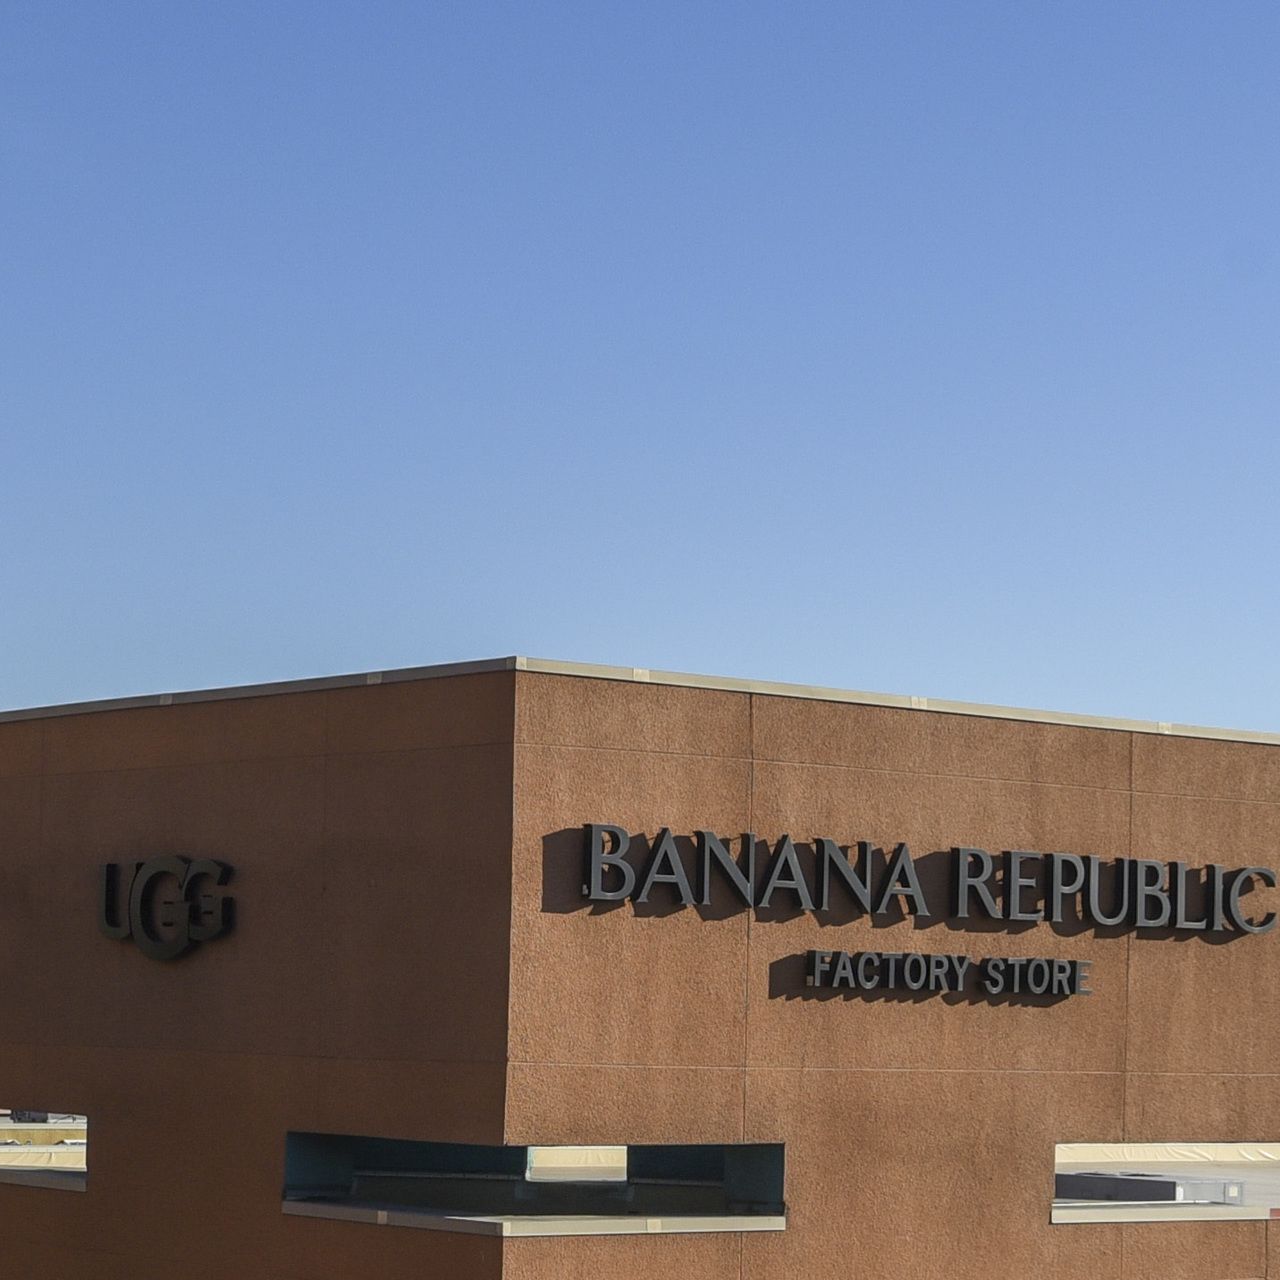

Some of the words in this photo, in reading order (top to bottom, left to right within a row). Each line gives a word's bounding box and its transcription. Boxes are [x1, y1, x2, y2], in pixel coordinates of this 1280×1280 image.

[98, 855, 235, 962] UGG
[583, 822, 930, 918] BANANA
[955, 846, 1279, 935] REPUBLIC
[814, 950, 970, 992] FACTORY
[984, 958, 1093, 996] STORE
